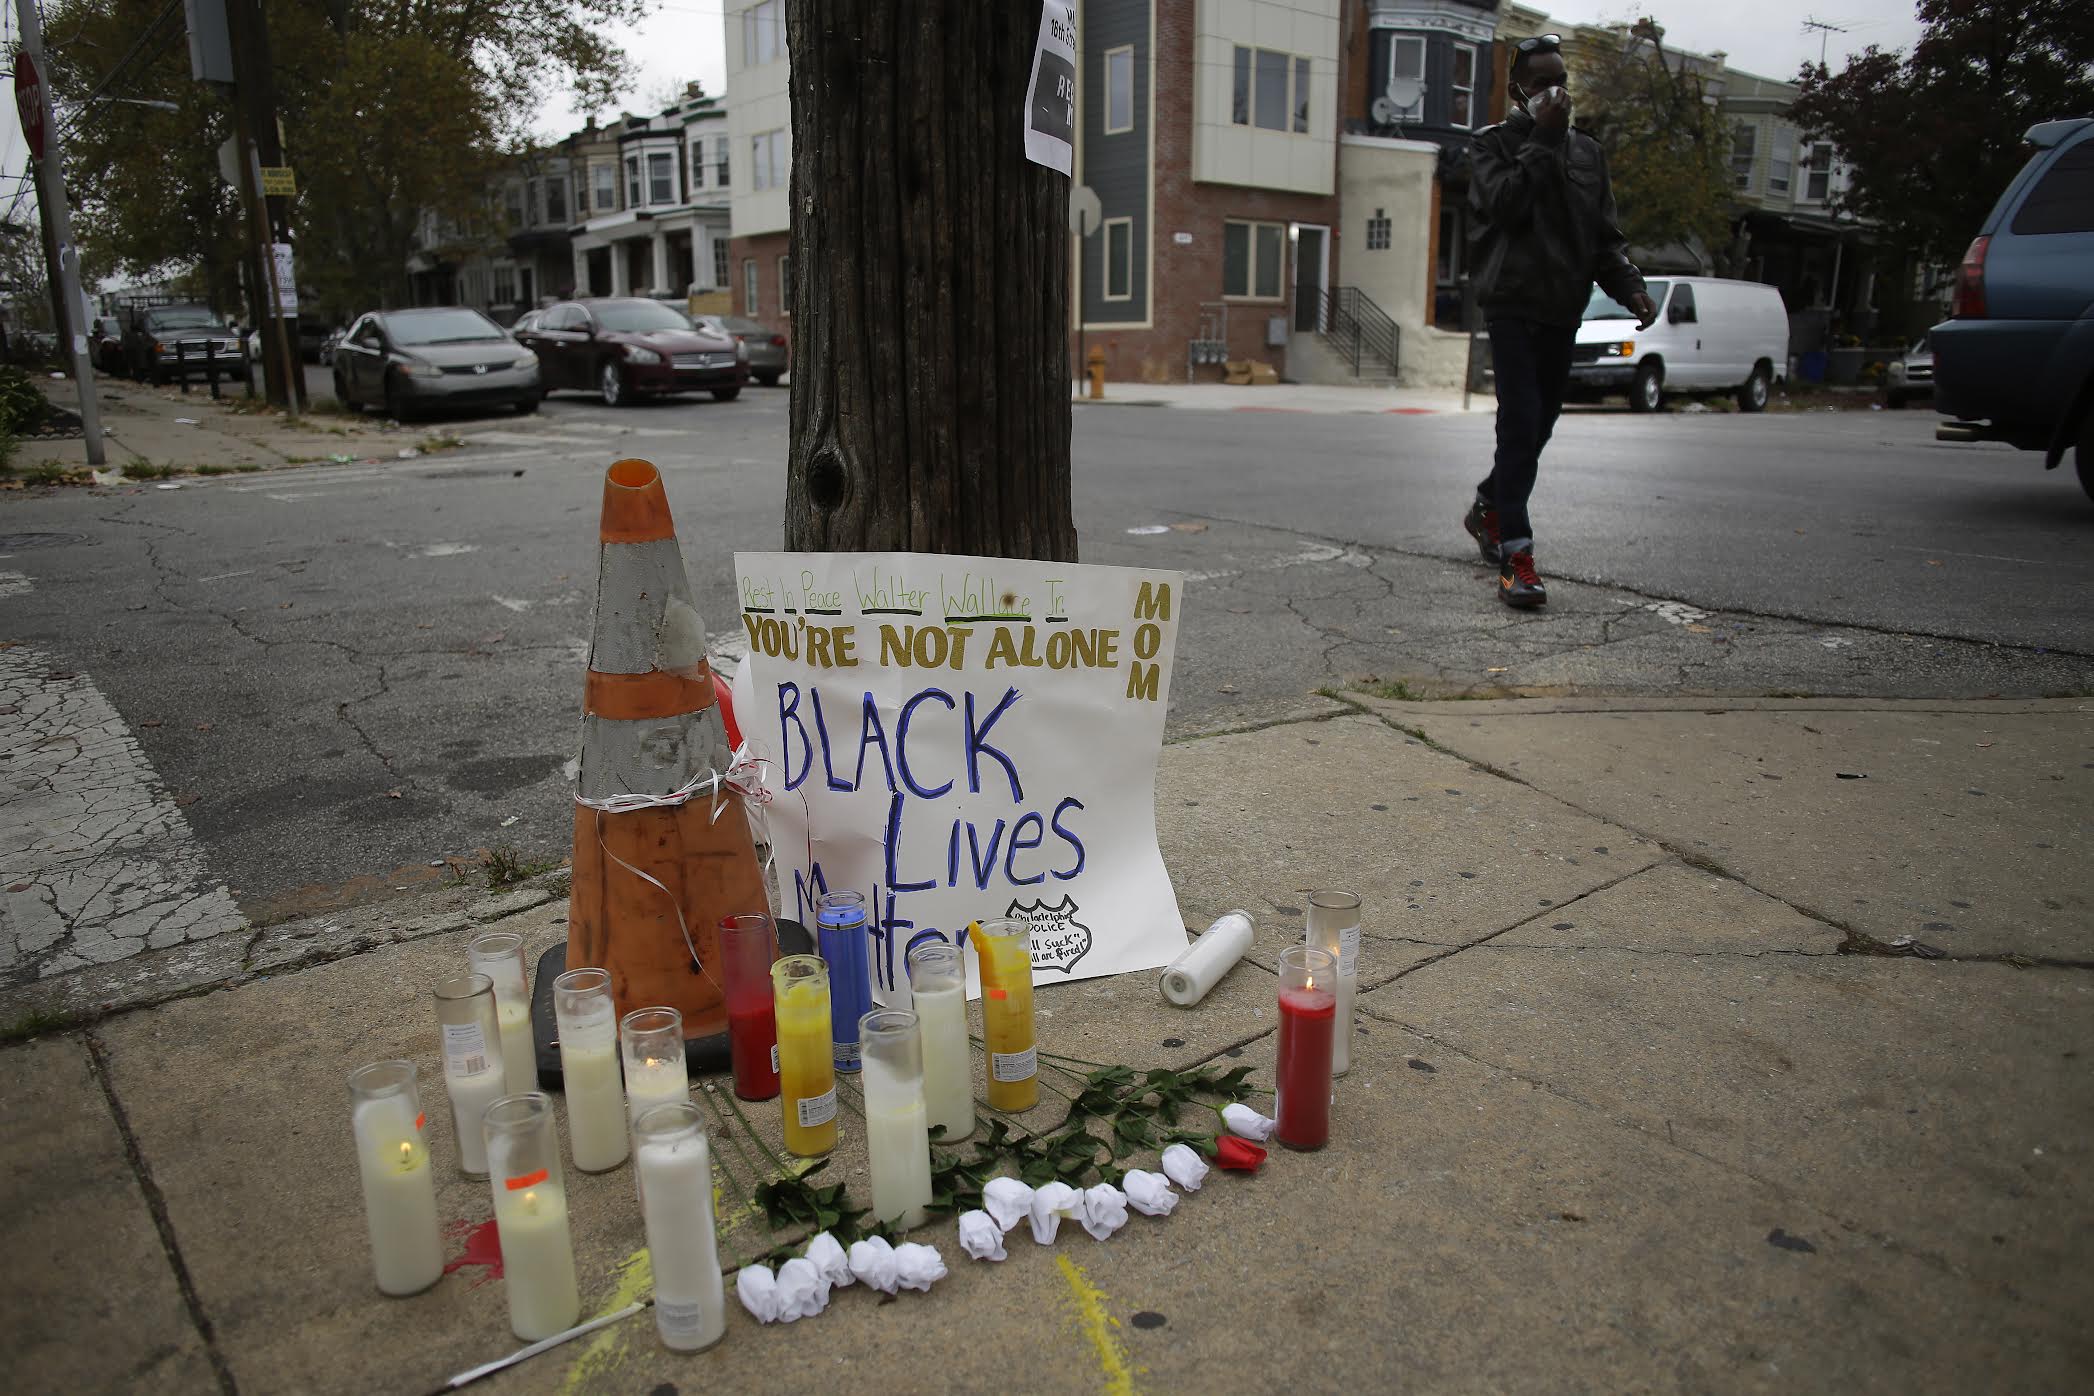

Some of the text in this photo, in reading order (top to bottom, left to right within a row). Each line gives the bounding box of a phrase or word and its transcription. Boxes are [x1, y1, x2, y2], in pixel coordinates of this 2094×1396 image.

[17, 85, 40, 129] STOP
[743, 576, 774, 608] Rest
[779, 576, 795, 608] In
[801, 570, 842, 609] Peace
[853, 566, 931, 609] Walter
[742, 613, 1120, 671] YOU'RE NOT ALONE
[1126, 581, 1171, 701] MOM
[777, 681, 1024, 803] BLACK
